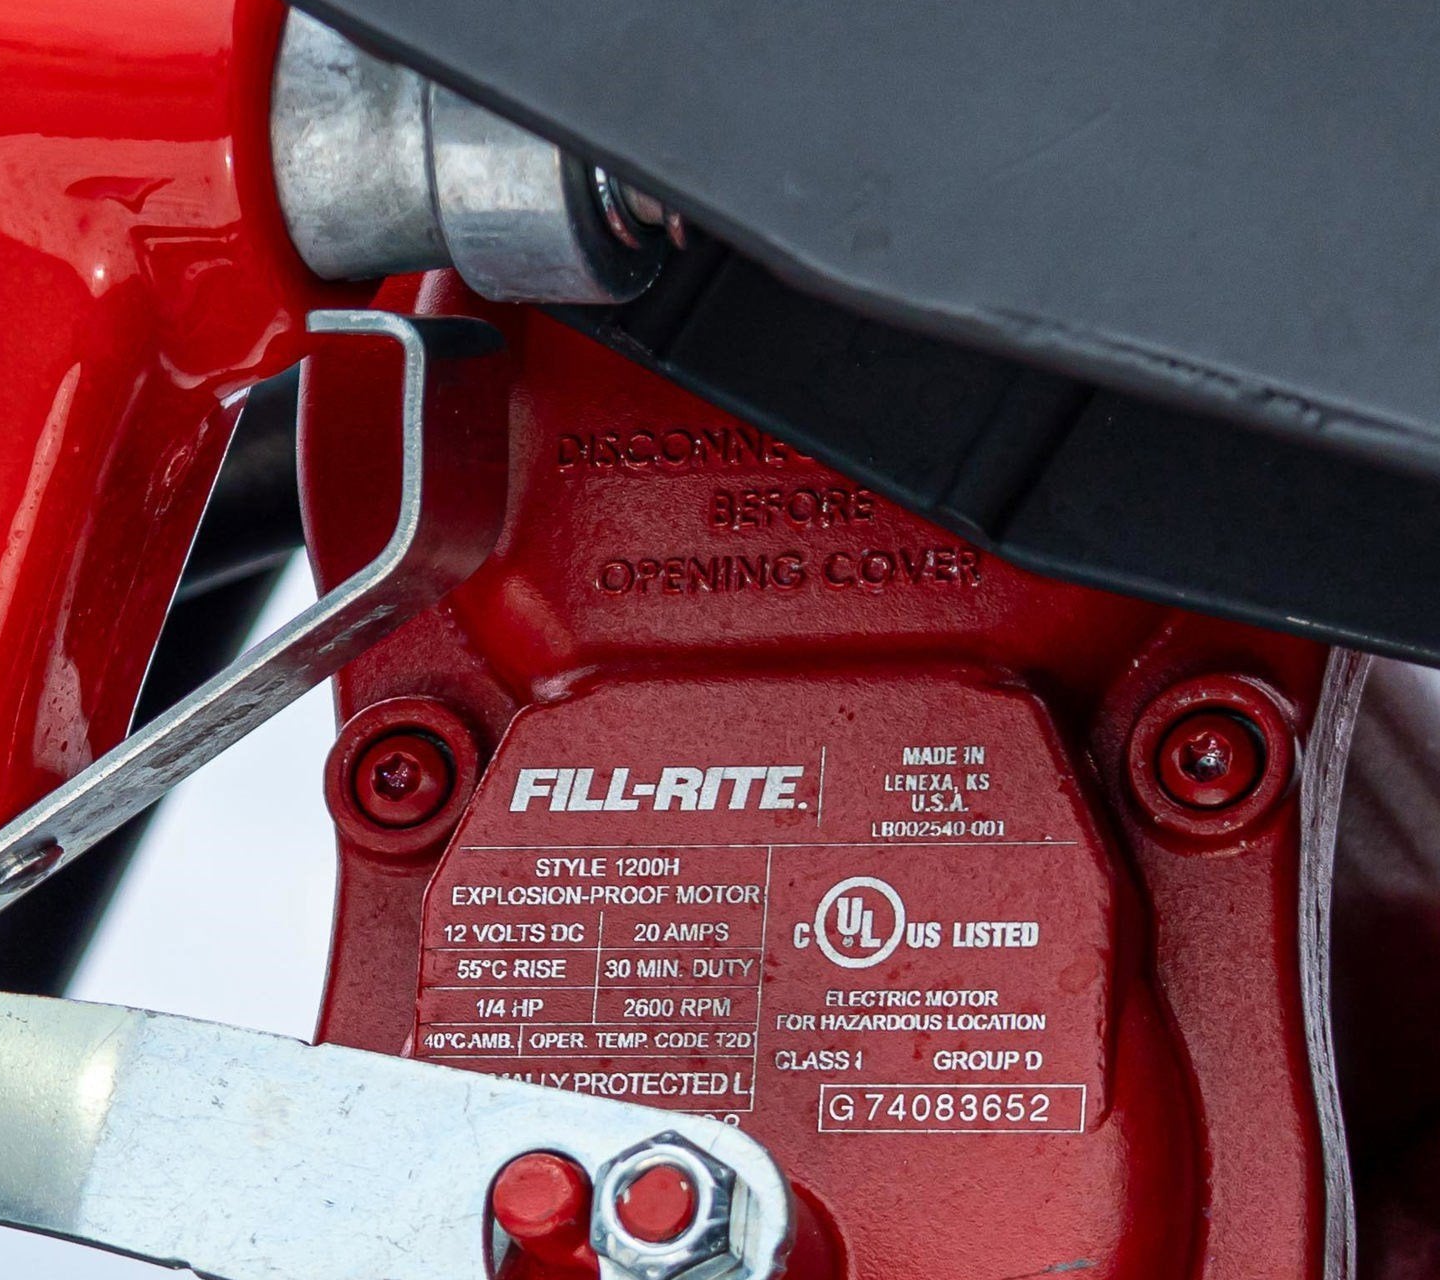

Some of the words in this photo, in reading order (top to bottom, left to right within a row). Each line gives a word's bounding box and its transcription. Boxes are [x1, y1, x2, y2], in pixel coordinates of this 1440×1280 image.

[556, 426, 816, 473] DISCONNE
[714, 487, 875, 530] BEFORE
[595, 553, 806, 596] OPENING
[824, 547, 983, 593] COVER
[902, 746, 958, 766] MADE
[963, 746, 985, 765] IN
[884, 773, 959, 795] LENEXA,
[966, 773, 990, 791] KS
[911, 789, 969, 813] U.S.A.
[535, 857, 607, 877] STYLE
[615, 857, 680, 877] 1200H
[452, 885, 670, 906] EXPLOSION-PROOF
[675, 885, 760, 904] MOTOR
[444, 924, 467, 942] 12
[472, 923, 546, 943] VOLTS
[550, 922, 585, 943] DC
[633, 923, 661, 942] 20
[662, 922, 729, 942] AMPS
[906, 921, 942, 949] US
[952, 921, 1039, 948] LISTED
[457, 959, 508, 980] 55°C
[512, 958, 567, 979] RISE
[604, 958, 631, 979] 30
[636, 959, 684, 979] MIN.
[693, 958, 754, 978] DUTY
[476, 998, 506, 1018] 1/4
[511, 998, 544, 1018] HP
[623, 998, 674, 1018] 2600
[679, 997, 731, 1017] RPM
[825, 990, 922, 1008] ELECTRIC
[924, 990, 999, 1008] MOTOR
[776, 1013, 816, 1031] FOR
[820, 1013, 943, 1031] HAZARDOUS
[946, 1013, 1046, 1031] LOCATION
[424, 1032, 466, 1049] 40°C
[467, 1032, 515, 1049] AMB.
[528, 1032, 588, 1050] OPER.
[595, 1032, 649, 1050] TEMP.
[653, 1032, 709, 1049] CODE
[775, 1050, 850, 1071] CLASS
[933, 1050, 1020, 1071] GROUP
[1025, 1050, 1043, 1071] D
[574, 1071, 729, 1096] PROTECTED
[829, 1094, 854, 1121] G
[865, 1093, 1050, 1122] 74083652
